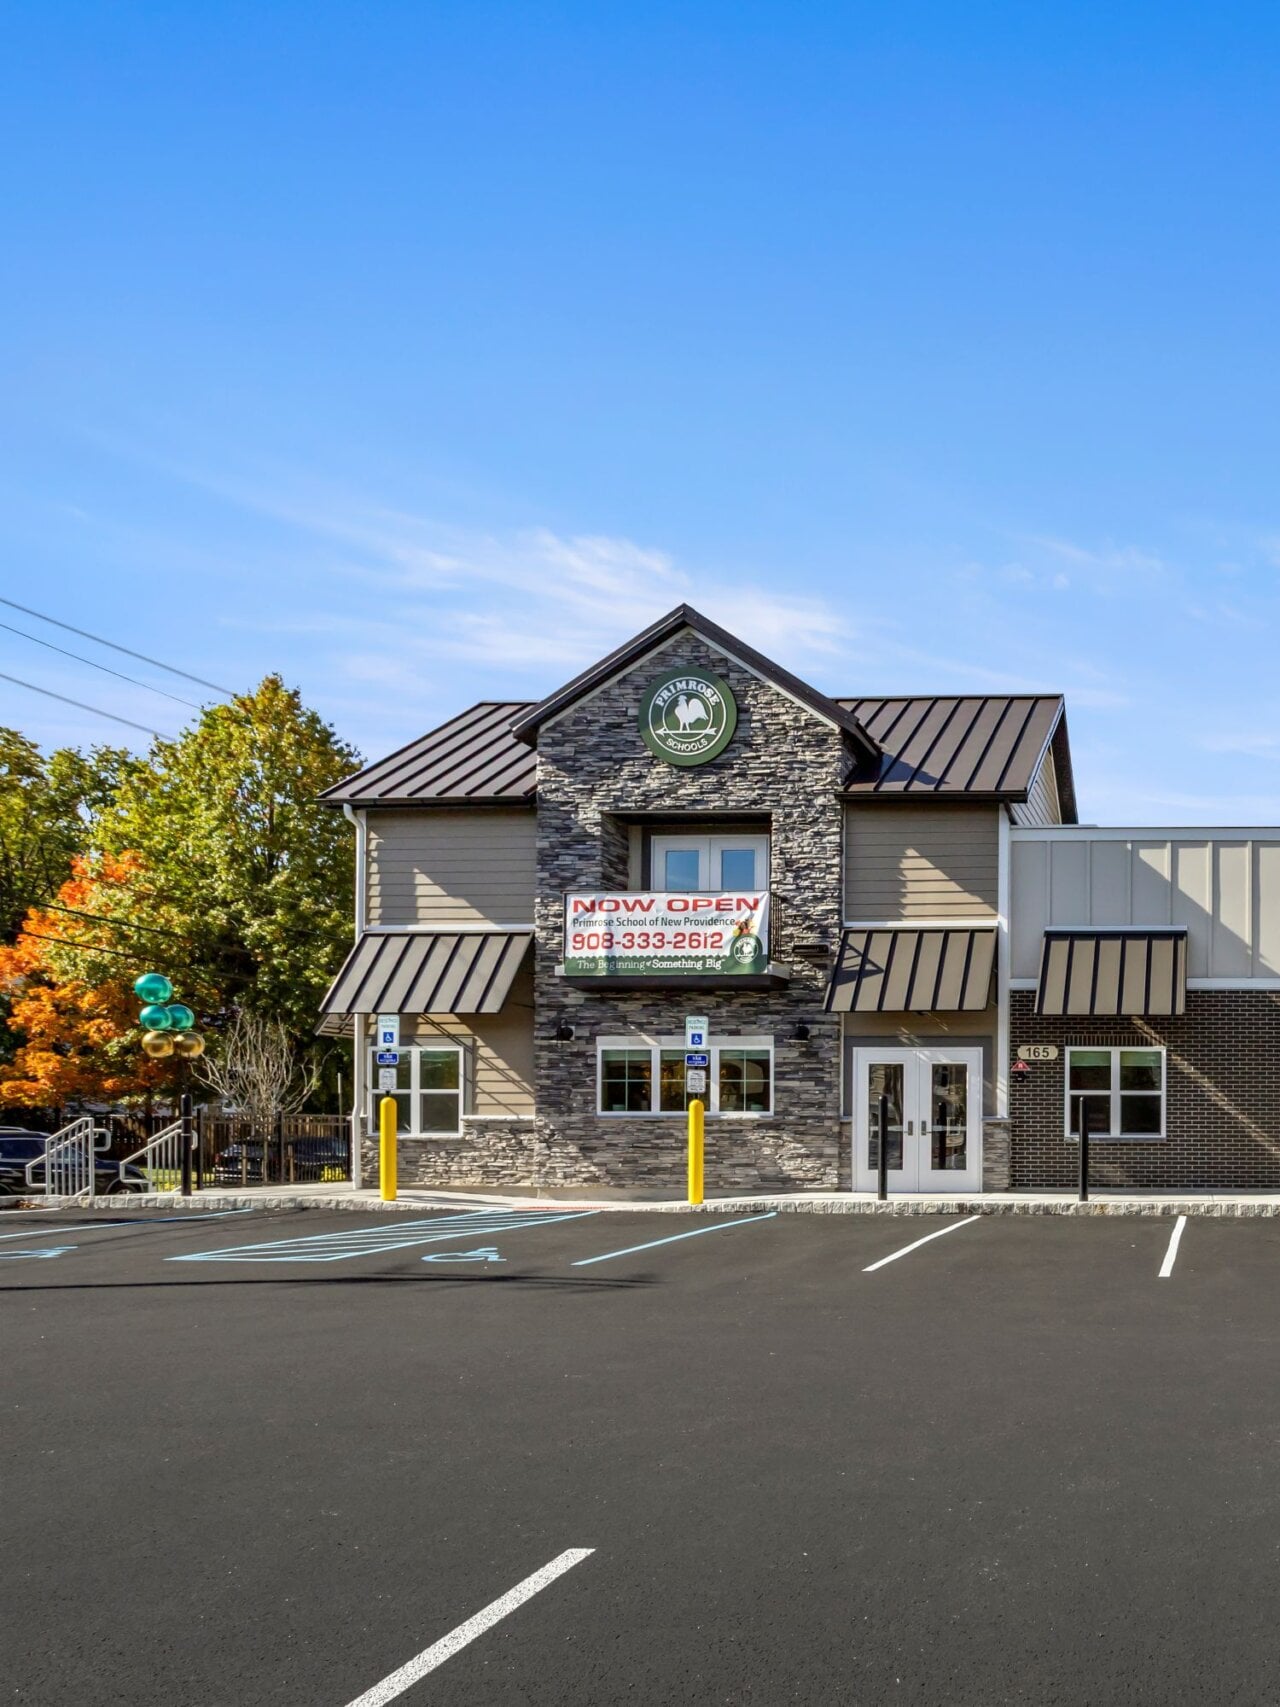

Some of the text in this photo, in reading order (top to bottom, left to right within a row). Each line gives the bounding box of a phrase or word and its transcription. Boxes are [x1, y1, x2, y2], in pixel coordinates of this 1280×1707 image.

[655, 680, 720, 707] PRIMROSE
[666, 738, 708, 751] SCHOOLS
[573, 897, 760, 913] NOW OPEN
[572, 916, 735, 928] Primrose School of New Providence
[572, 932, 723, 950] 908-333-2612
[577, 960, 595, 969] The
[598, 960, 645, 970] Beginning
[652, 959, 703, 970] Something
[1026, 1047, 1049, 1058] 165
